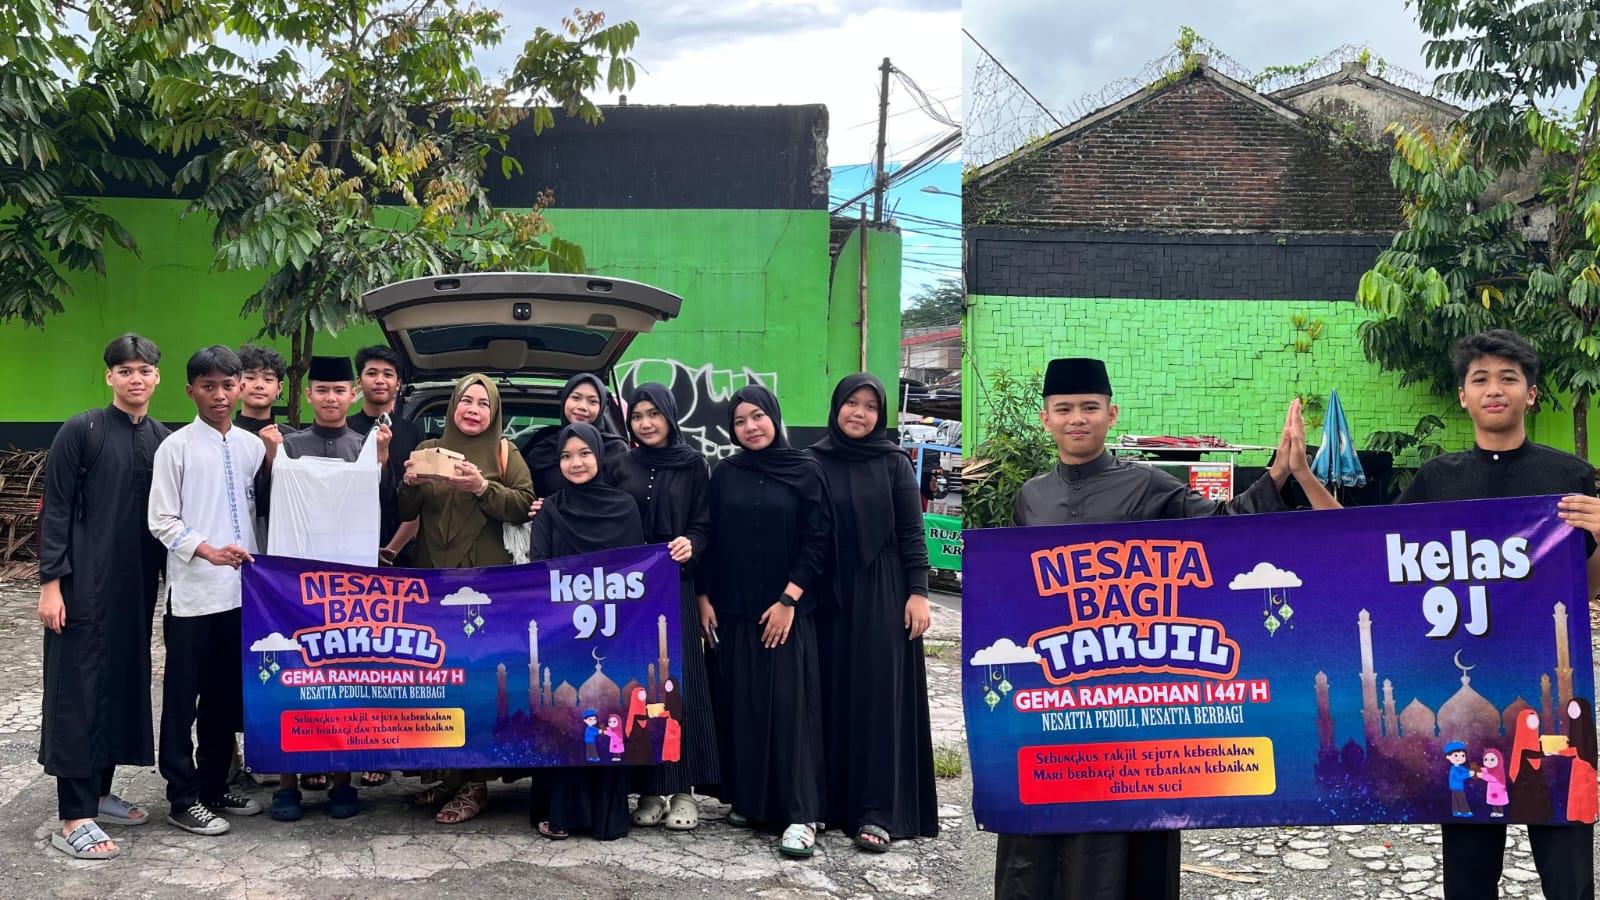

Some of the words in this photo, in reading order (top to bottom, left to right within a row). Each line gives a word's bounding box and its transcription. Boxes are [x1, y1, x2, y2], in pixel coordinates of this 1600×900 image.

[1037, 545, 1206, 590] NESATA
[1386, 530, 1531, 582] kelas
[304, 574, 425, 600] NESATA
[550, 567, 645, 601] kelas
[329, 598, 399, 623] BAGI
[1073, 583, 1172, 621] BAGI
[301, 627, 438, 658] TAKJIL
[1039, 625, 1229, 671] TAKJIL
[281, 670, 325, 684] GEMA
[328, 669, 414, 684] RAMADHAN
[419, 670, 448, 683] 1447
[452, 670, 463, 682] H
[300, 686, 337, 700] NESATTA
[371, 685, 407, 698] NESATTA
[409, 685, 446, 699] BERBAGI
[1015, 691, 1075, 709] GEMA
[1079, 685, 1199, 706] RAMADHAN
[1206, 683, 1246, 702] 1447
[1252, 682, 1267, 700] H
[1042, 710, 1093, 731] NESATTA
[1095, 708, 1139, 729] PEDULI,
[1141, 706, 1191, 727] NESATTA
[1194, 705, 1244, 724] BERBAGI
